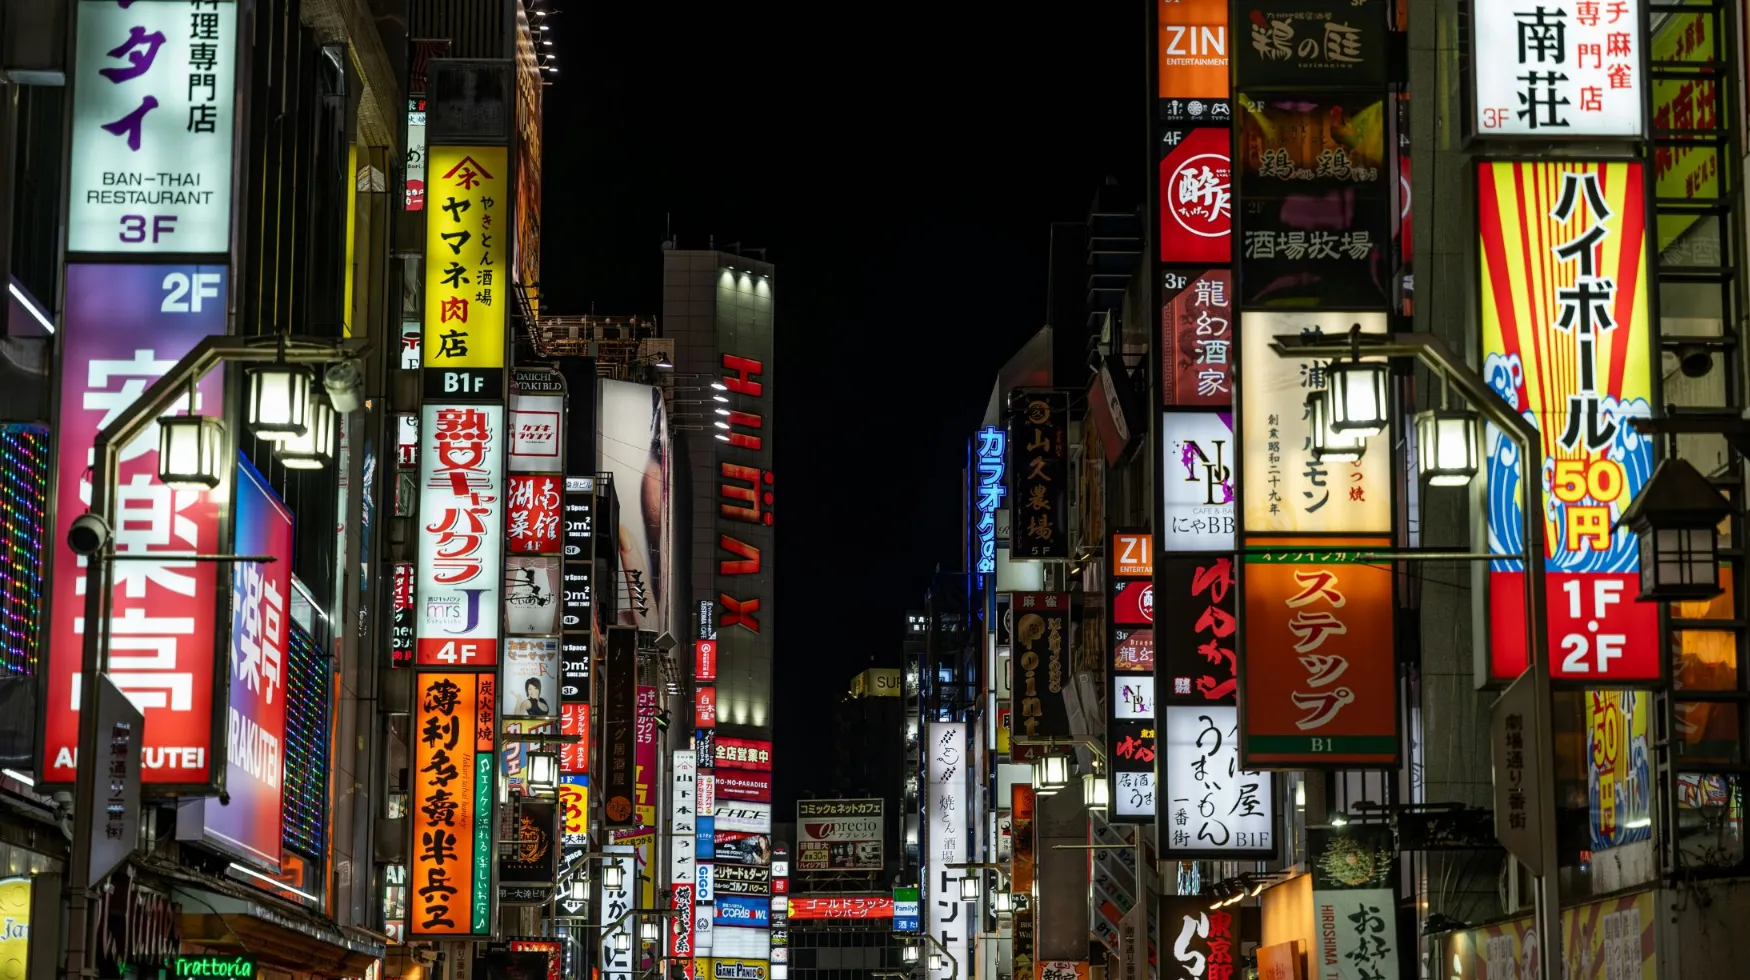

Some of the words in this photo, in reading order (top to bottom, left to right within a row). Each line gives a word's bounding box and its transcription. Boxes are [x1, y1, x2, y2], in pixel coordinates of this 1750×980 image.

[1166, 26, 1224, 55] ZIN
[1513, 6, 1571, 129] 南荘
[1576, 1, 1603, 112] 専門店
[99, 0, 166, 151] タイ
[1247, 101, 1265, 112] 2F
[1483, 109, 1509, 128] 3F
[1163, 132, 1182, 145] 4F
[102, 172, 200, 186] BAN-THAI
[87, 191, 213, 204] RESTAURANT
[119, 215, 178, 243] 3F
[475, 196, 495, 306] やきとん酒場
[1245, 230, 1373, 260] 酒場牧場
[435, 197, 472, 359] ヤマネ肉店
[1164, 273, 1187, 289] 3F
[160, 272, 221, 313] 2F
[1550, 172, 1617, 453] ハイボール
[1194, 279, 1230, 396] 龍幻酒家
[444, 372, 484, 392] B1F
[516, 373, 551, 381] DAIICHI
[542, 383, 562, 391] BLD
[1300, 325, 1329, 514] 浦モン
[1267, 414, 1282, 516] 創業昭和二十九年
[508, 479, 560, 510] 湖南
[1026, 428, 1054, 541] 山久農場
[1553, 460, 1623, 503] 50
[426, 408, 498, 584] 熟女キャバクラ
[1192, 507, 1213, 515] CAFE
[1214, 507, 1220, 515] &
[1566, 505, 1613, 551] 円
[1031, 546, 1050, 555] 5F
[1119, 537, 1147, 564] ZI
[1115, 582, 1126, 591] 4F
[1562, 580, 1624, 618] 1F
[1023, 596, 1058, 608] 麻雀
[1116, 630, 1128, 640] 3F
[437, 642, 478, 664] 4F
[1284, 570, 1356, 731] ステップ
[1560, 634, 1626, 672] 2F
[477, 681, 494, 742] 炭火串焼
[577, 706, 585, 745] レンタルルム
[560, 705, 572, 771] リフッシュ
[1310, 738, 1333, 751] B1
[54, 746, 205, 769] AUTEI
[715, 745, 769, 763] 全店営業中
[1190, 715, 1230, 846] うまいもん
[1504, 713, 1526, 830] 劇場通り一番街
[714, 808, 769, 819] FACE
[800, 804, 881, 814] コミック&ネットカフェ
[1173, 798, 1190, 847] 一番街
[566, 834, 586, 843] 天神
[939, 795, 956, 863] 焼とん酒場
[1236, 831, 1269, 847] B1F
[565, 850, 582, 863] pace
[500, 889, 546, 898] 第一大滝ビル
[698, 866, 708, 898] GiGO
[729, 882, 748, 891] ゴルフ
[824, 908, 868, 918] ハンバーグ
[898, 920, 907, 929] 酒
[938, 871, 958, 980] トント
[1320, 905, 1338, 966] HIROSHIMA
[715, 963, 735, 978] GAME
[736, 963, 757, 978] PANIC
